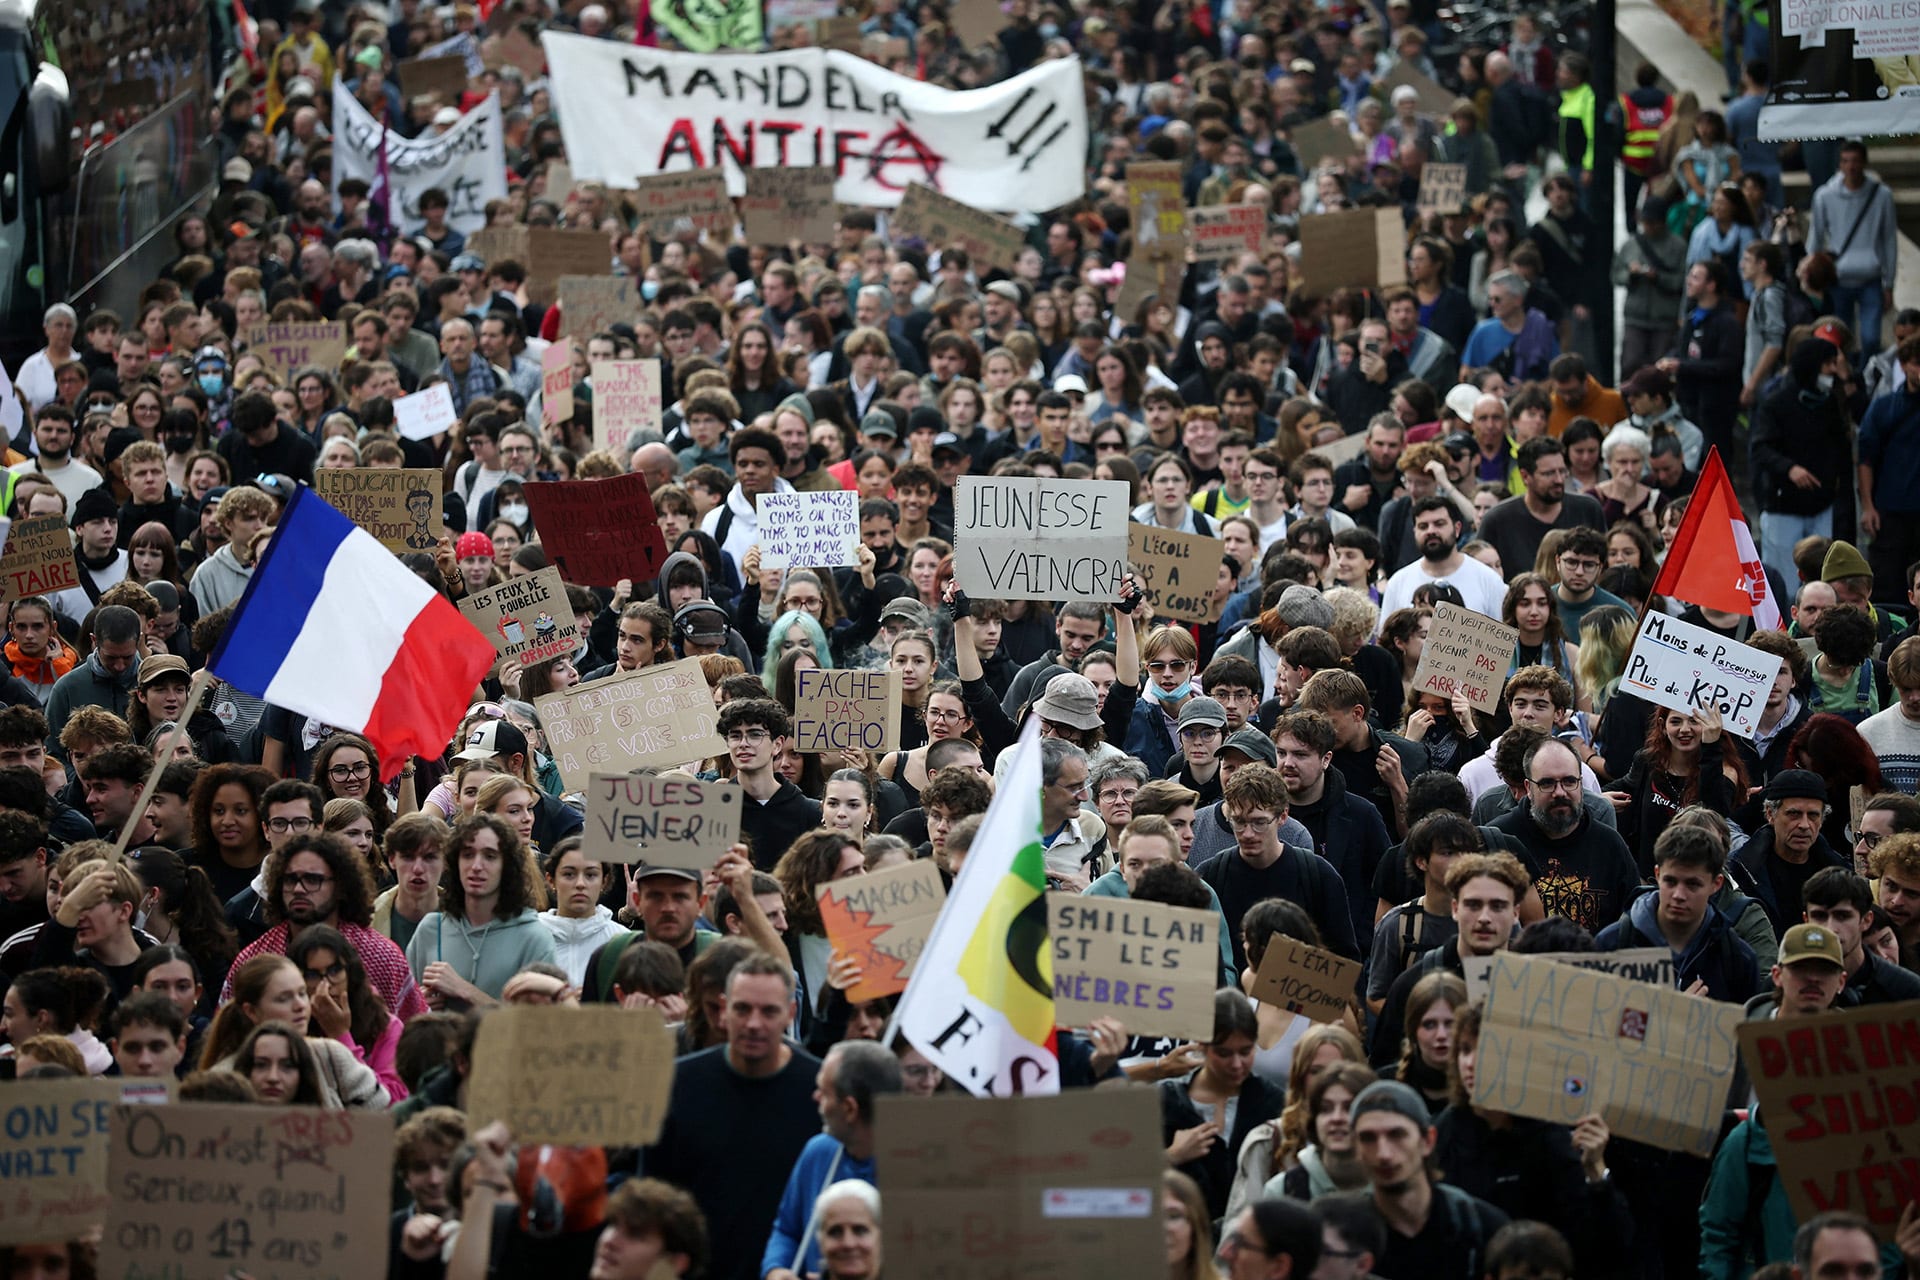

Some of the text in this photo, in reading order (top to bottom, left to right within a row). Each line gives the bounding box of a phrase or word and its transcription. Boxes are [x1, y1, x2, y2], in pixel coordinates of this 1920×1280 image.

[622, 58, 913, 122] MANDELA
[658, 116, 947, 192] ANTIFA
[320, 470, 432, 493] L'ÉDUCATION
[355, 495, 375, 508] PAS
[769, 511, 803, 524] COME
[809, 509, 825, 521] ON
[966, 485, 1108, 531] JEUNESSE
[21, 535, 53, 551] MAIS
[794, 526, 809, 538] TO
[844, 523, 858, 535] UP
[41, 547, 72, 561] NOUS
[796, 542, 810, 553] TO
[814, 540, 842, 553] MOVE
[824, 552, 845, 565] ASS
[1143, 535, 1189, 558] L'ÉCOLE
[978, 546, 1123, 595] VAINCRA
[473, 576, 541, 610] LES FEUX DE
[500, 587, 550, 615] POUBELLE
[505, 641, 526, 656] FAIT
[529, 633, 555, 648] PEUR
[559, 624, 577, 639] AUX
[1438, 607, 1518, 644] ON VEUT PRENDRE
[1644, 616, 1688, 650] Moins
[1693, 644, 1708, 658] de
[520, 637, 576, 664] ORDURES
[1431, 642, 1496, 672] AVENIR PAS
[1439, 626, 1453, 638] EN
[1485, 643, 1512, 658] NOTRE
[653, 672, 696, 692] DEUX
[799, 670, 885, 700] FACHE
[1429, 660, 1488, 684] SE LA FAIRE
[1628, 655, 1657, 686] Plus
[1665, 682, 1680, 696] de
[1425, 675, 1488, 703] ARRACHER
[825, 700, 864, 722] PAS
[563, 752, 579, 772] A
[586, 743, 611, 764] CE
[617, 723, 676, 757] VOIRE
[798, 721, 883, 749] FACHO
[600, 777, 704, 807] JULES
[845, 875, 934, 923] MACRON
[1120, 943, 1181, 969] LES
[1486, 958, 1735, 1078] MACRON PAS
[1475, 1031, 1532, 1110] DU
[6, 1101, 111, 1140] ON SE
[1785, 1076, 1920, 1142] SOLID
[258, 1174, 346, 1224] quand
[117, 1222, 161, 1249] on
[206, 1218, 254, 1259] 17
